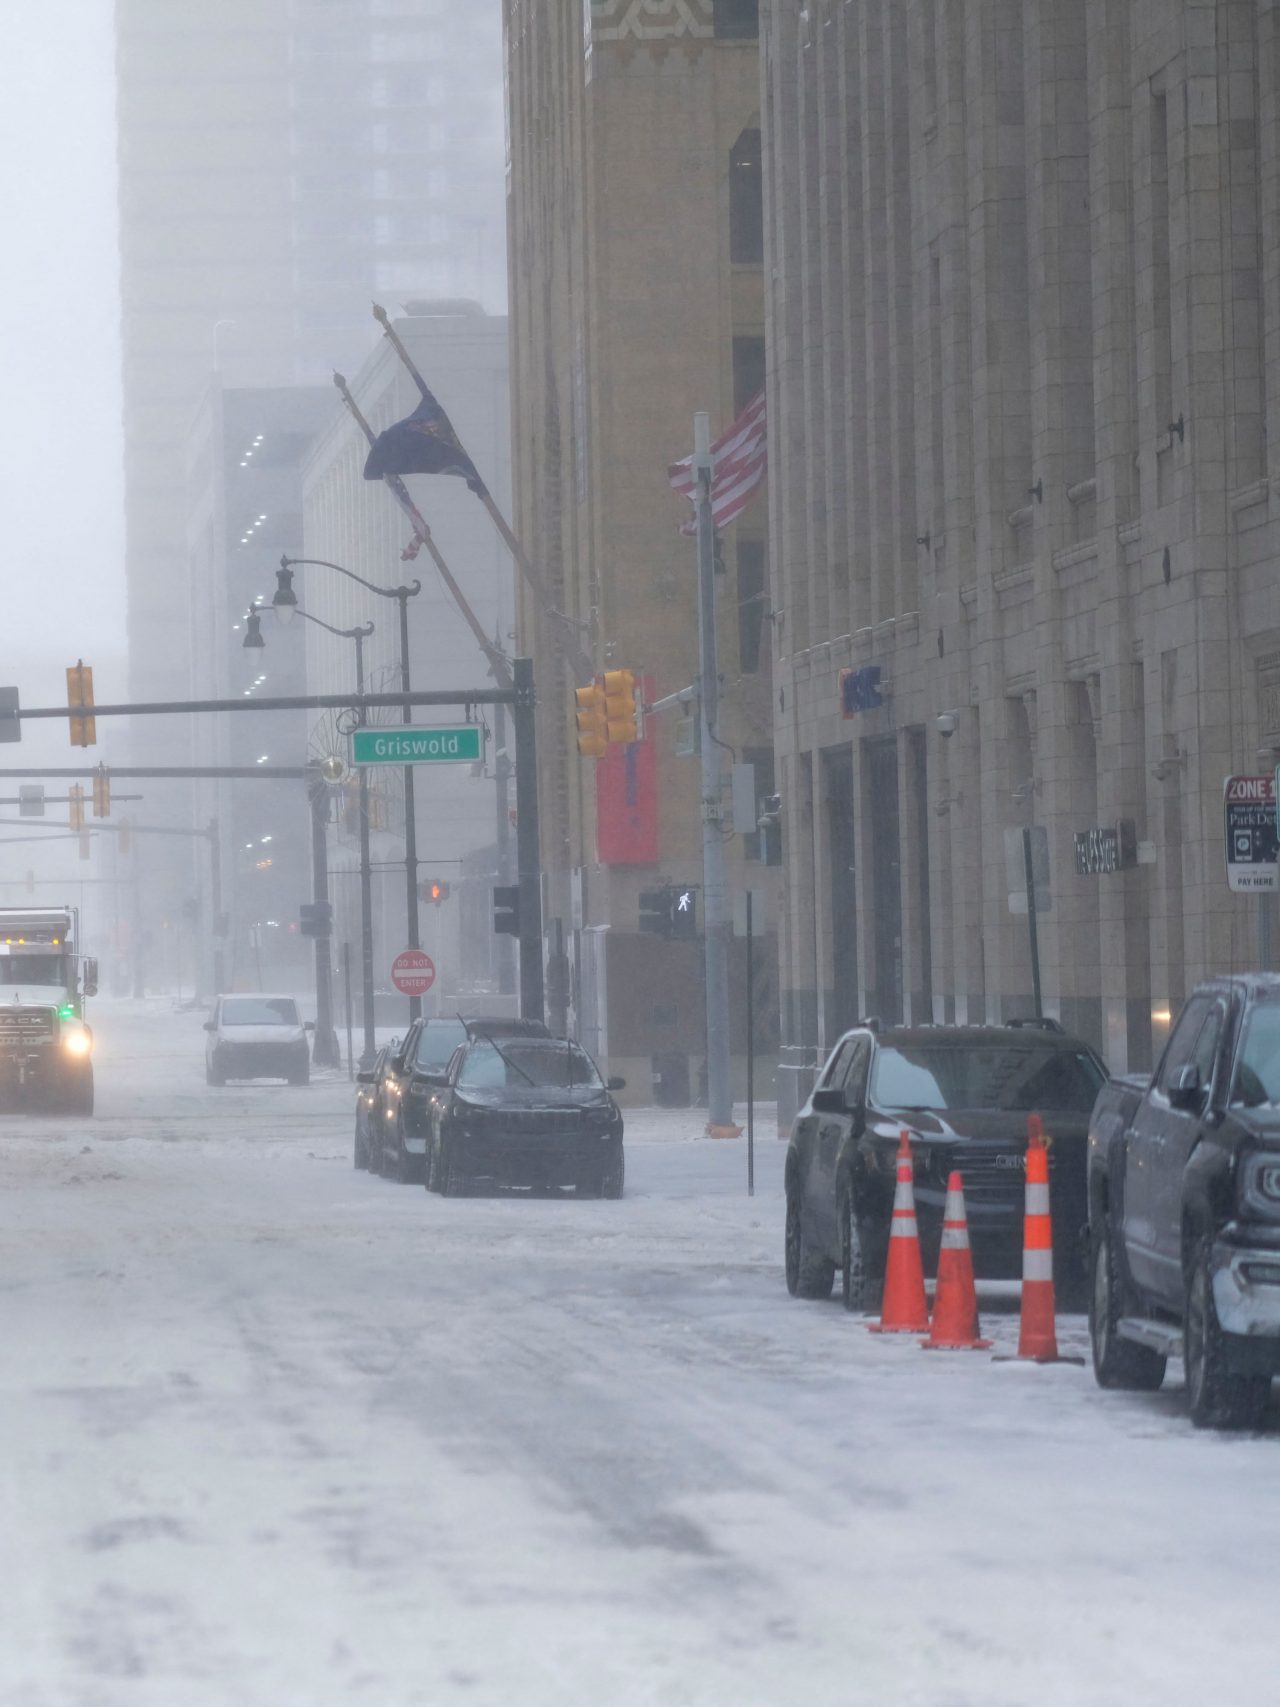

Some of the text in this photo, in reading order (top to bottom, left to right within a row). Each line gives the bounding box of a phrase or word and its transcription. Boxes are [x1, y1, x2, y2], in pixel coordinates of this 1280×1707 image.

[374, 735, 459, 756] Griswold
[1228, 779, 1266, 799] ZONE
[1237, 877, 1273, 886] PAY HERE
[397, 959, 428, 967] DO NOT
[400, 979, 426, 987] ENTER
